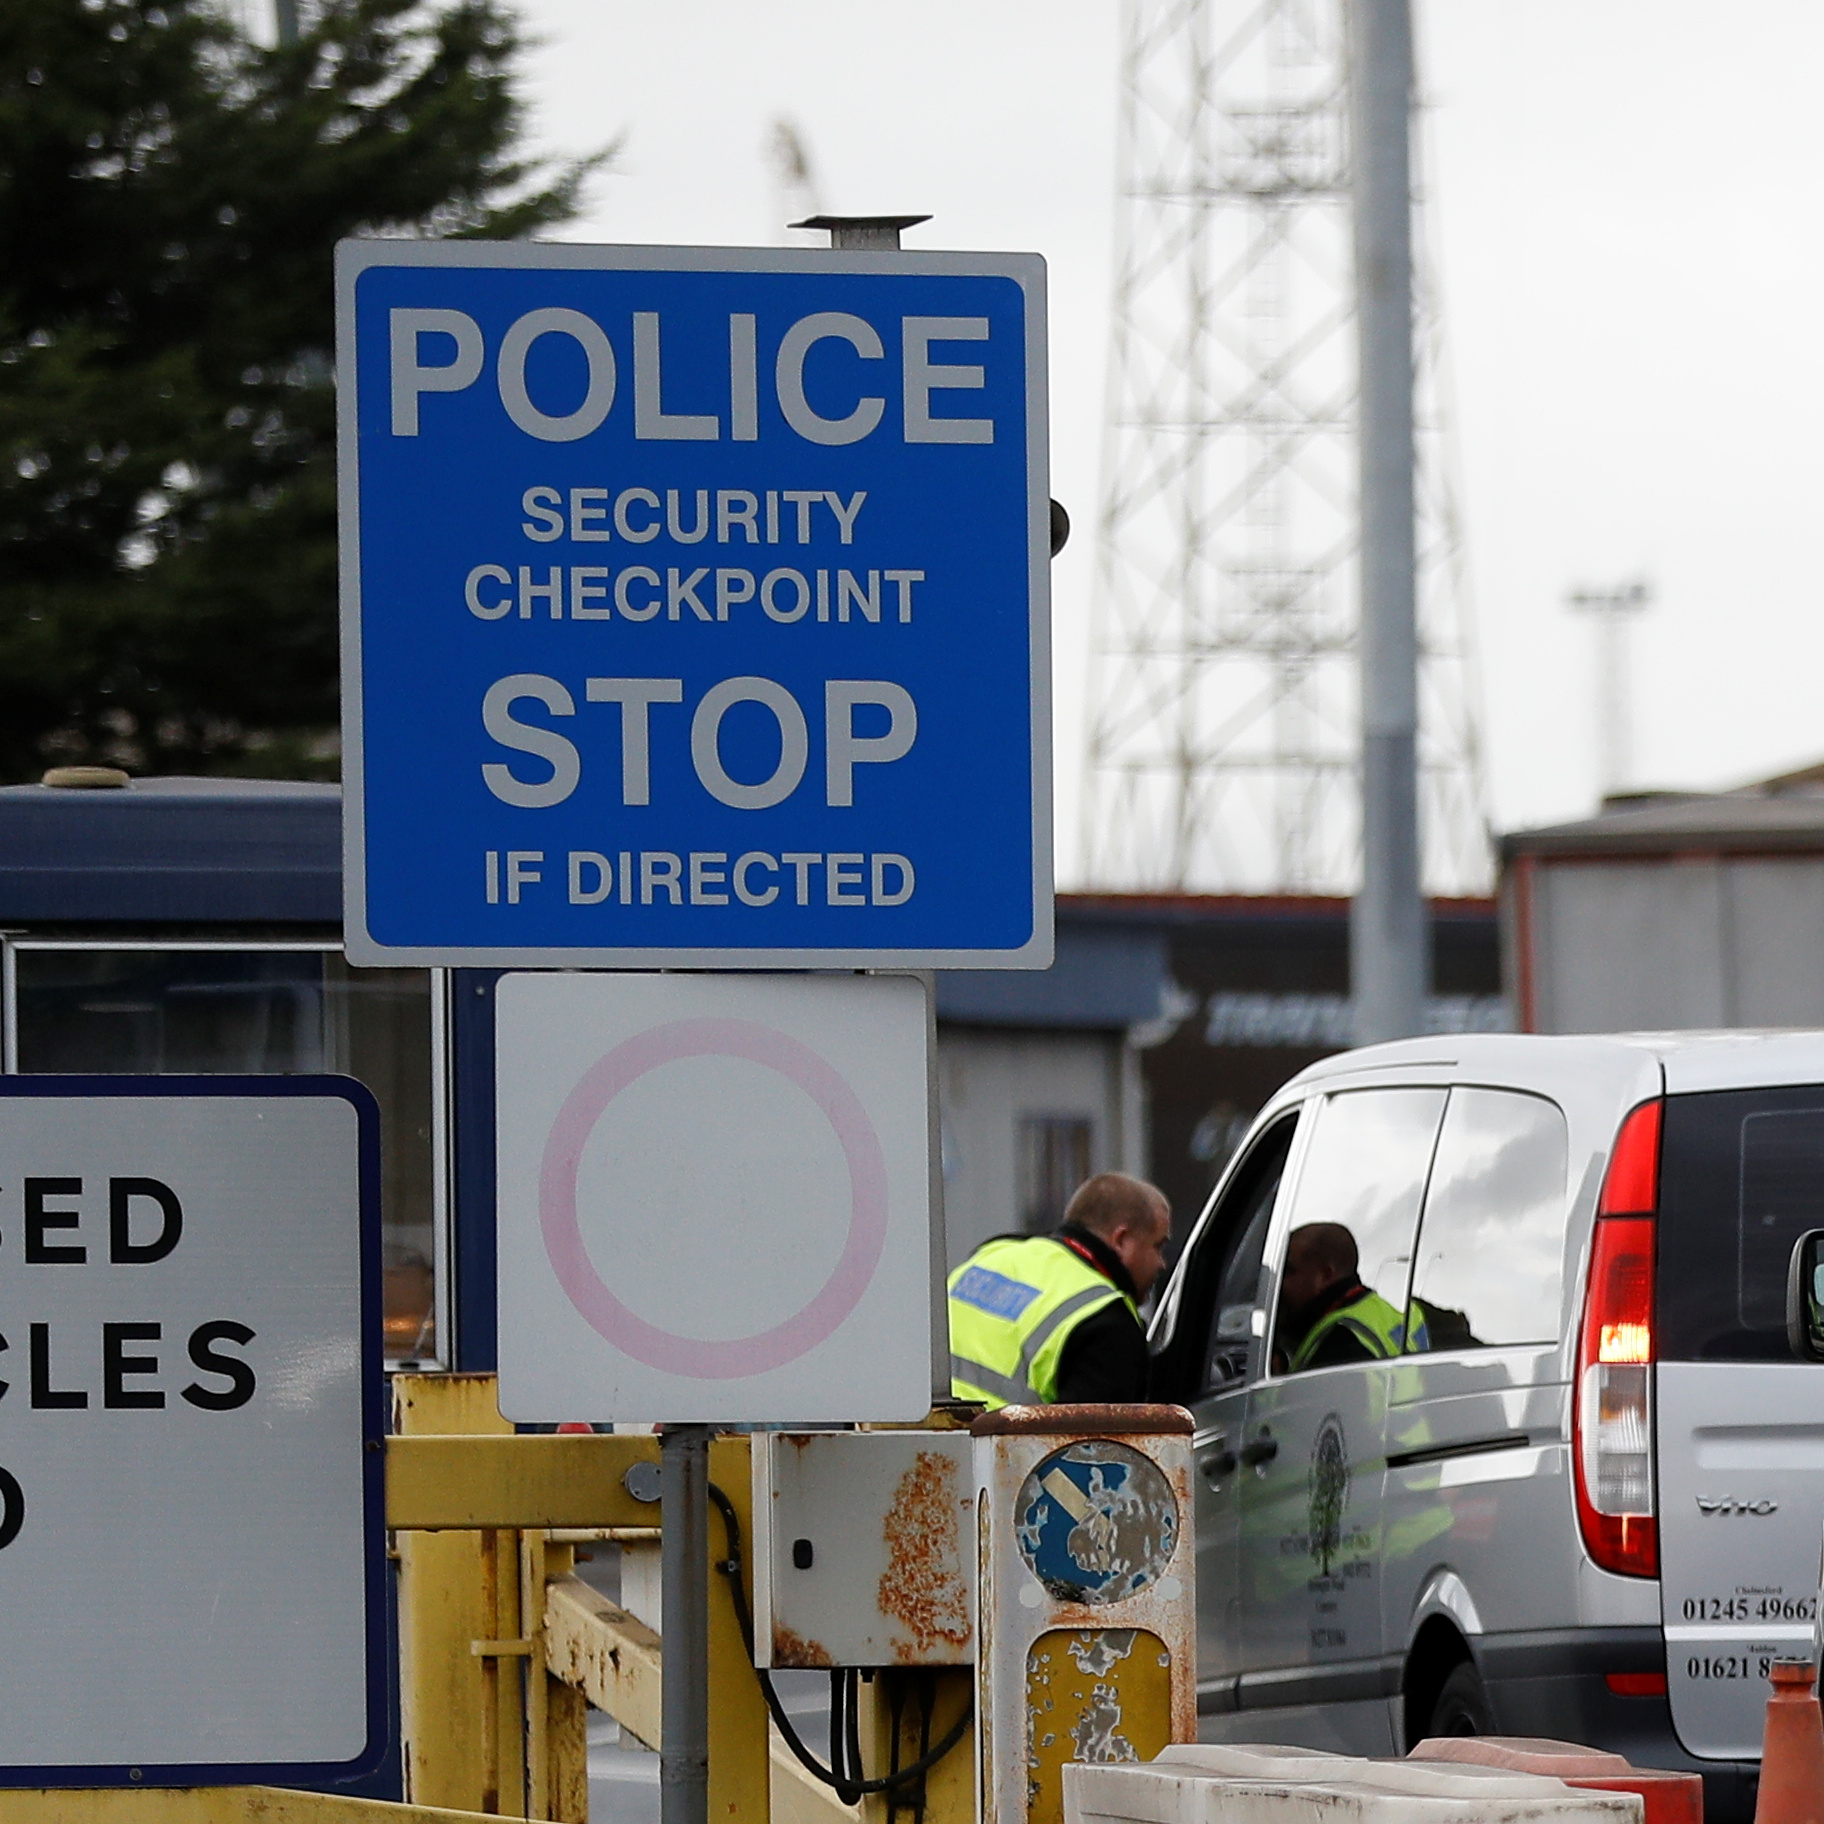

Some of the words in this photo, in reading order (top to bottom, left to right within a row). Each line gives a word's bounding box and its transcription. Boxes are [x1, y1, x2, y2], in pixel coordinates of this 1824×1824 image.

[389, 307, 994, 447] POLICE
[521, 487, 867, 546] SECURITY
[465, 564, 925, 624] CHECKPOINT
[480, 672, 919, 811] STOP
[485, 851, 543, 906] IF
[569, 851, 916, 907] DIRECTED
[0, 1177, 183, 1264] ED
[0, 1320, 257, 1411] LES
[1683, 1598, 1748, 1620] 01245
[1687, 1657, 1749, 1679] 01621
